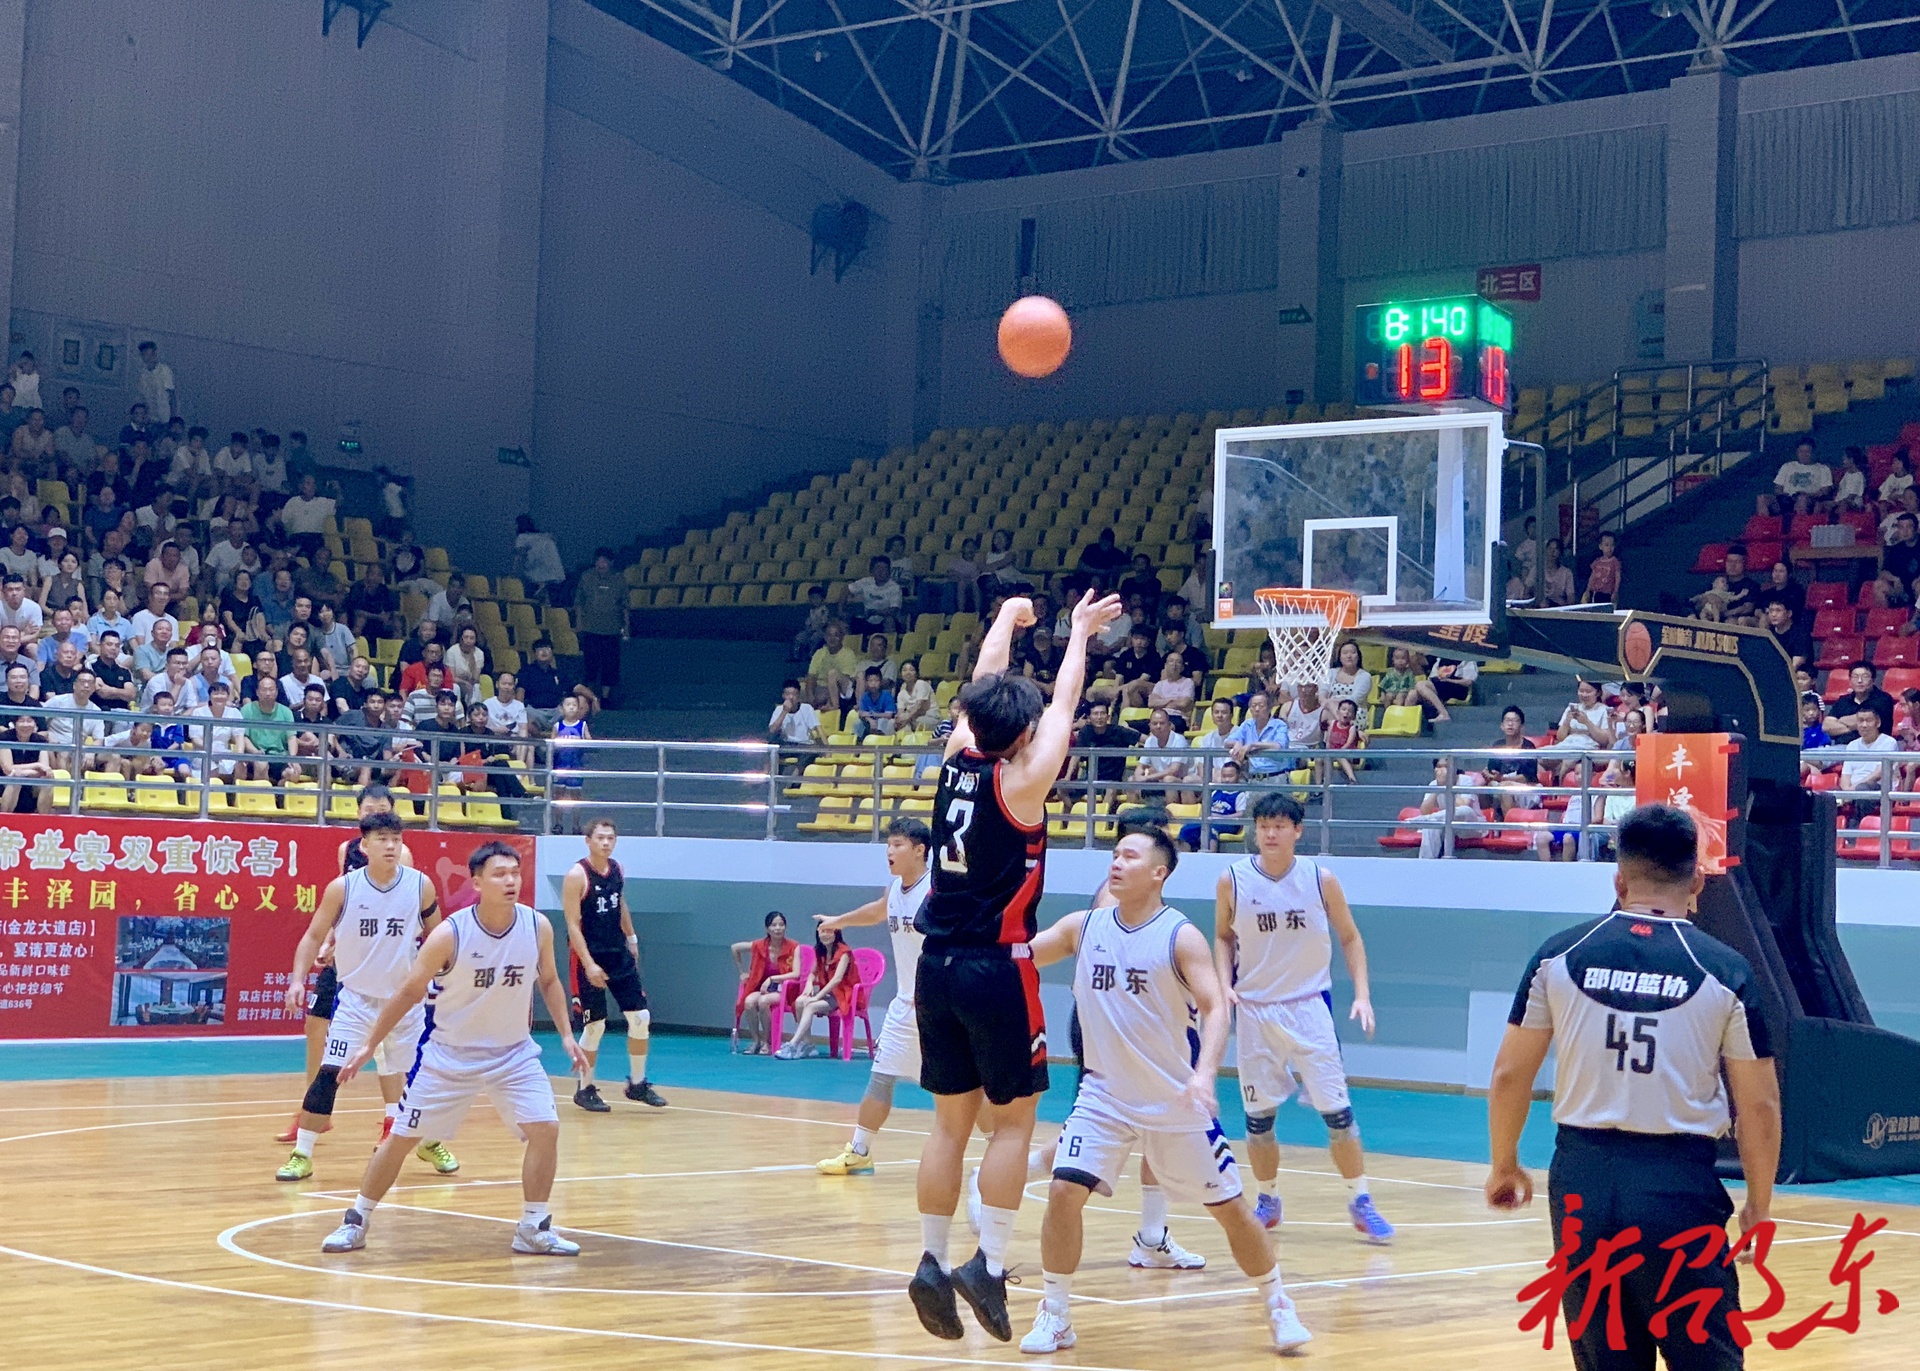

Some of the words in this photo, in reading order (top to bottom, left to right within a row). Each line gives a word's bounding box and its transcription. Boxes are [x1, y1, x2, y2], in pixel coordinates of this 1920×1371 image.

[1481, 270, 1537, 294] 北三区
[1399, 338, 1450, 397] 13
[939, 798, 975, 874] 3
[360, 918, 405, 938] 邵东
[1256, 909, 1307, 933] 邵东
[473, 965, 525, 988] 邵东
[1091, 964, 1149, 995] 邵东
[1583, 967, 1689, 999] 邵阳篮协
[0, 982, 64, 995] 心把控细节
[329, 1039, 348, 1058] 99
[1605, 1013, 1659, 1074] 45
[1243, 1085, 1258, 1103] 12
[408, 1108, 421, 1129] 8
[1068, 1136, 1083, 1158] 6
